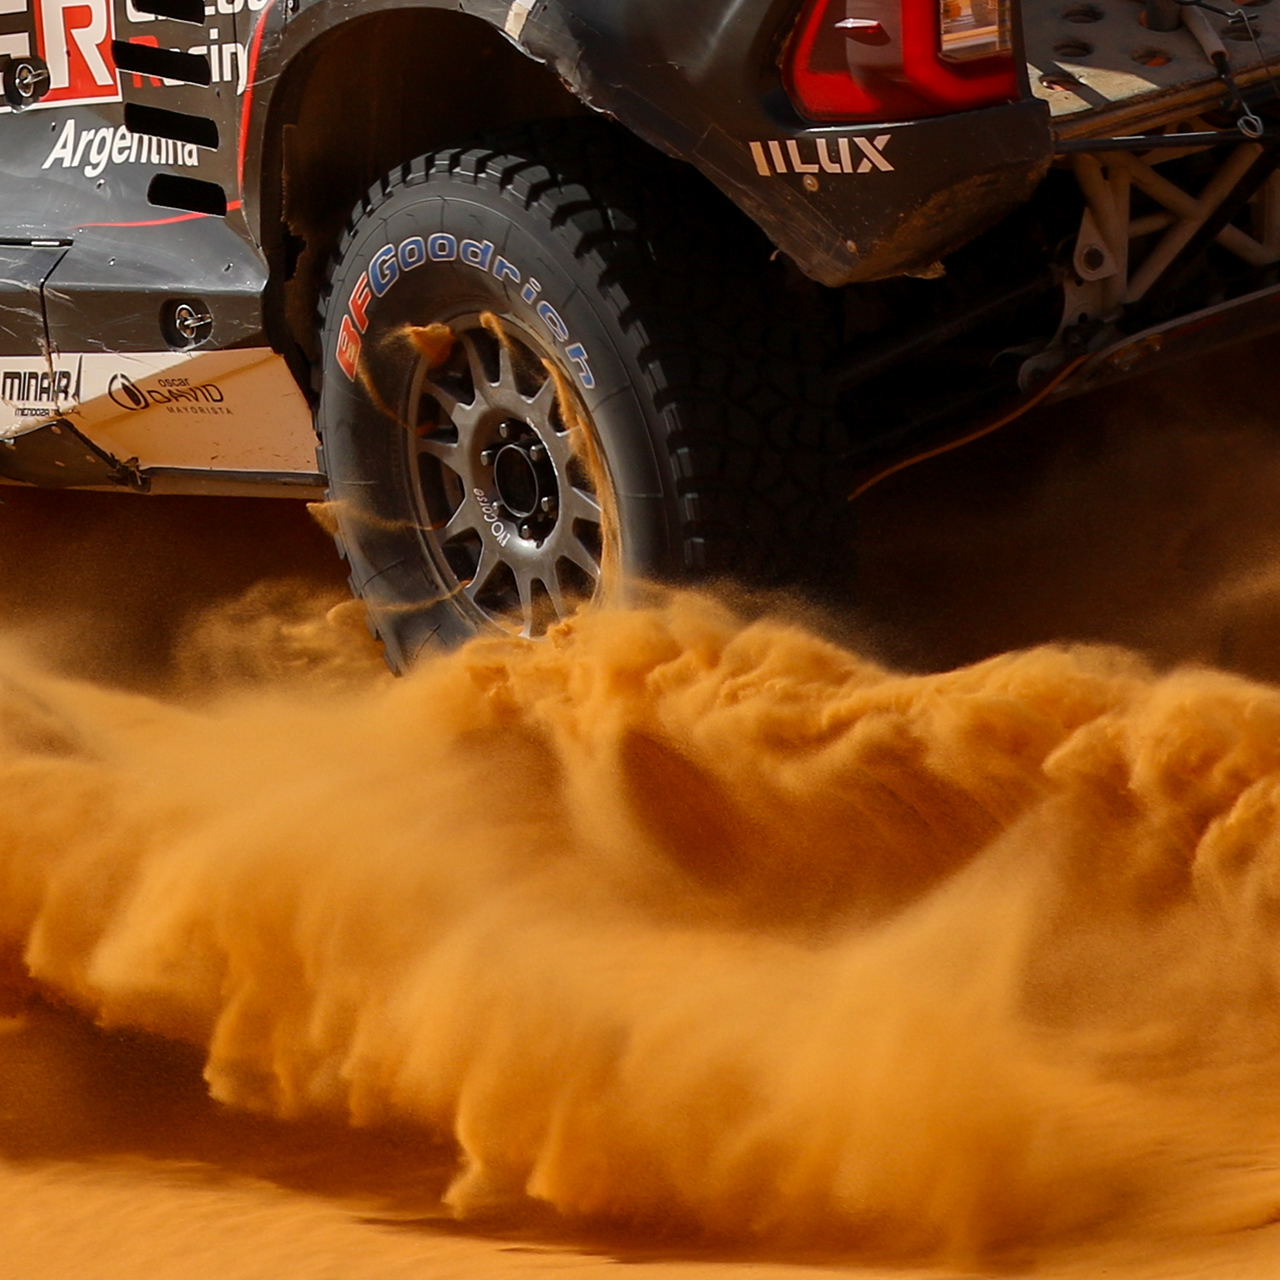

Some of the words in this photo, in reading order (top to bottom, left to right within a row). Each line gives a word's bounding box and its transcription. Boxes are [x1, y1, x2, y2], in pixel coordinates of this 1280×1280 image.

[335, 231, 596, 390] BFGoodrich
[158, 377, 191, 388] oscar
[166, 406, 234, 415] MAYORISTA
